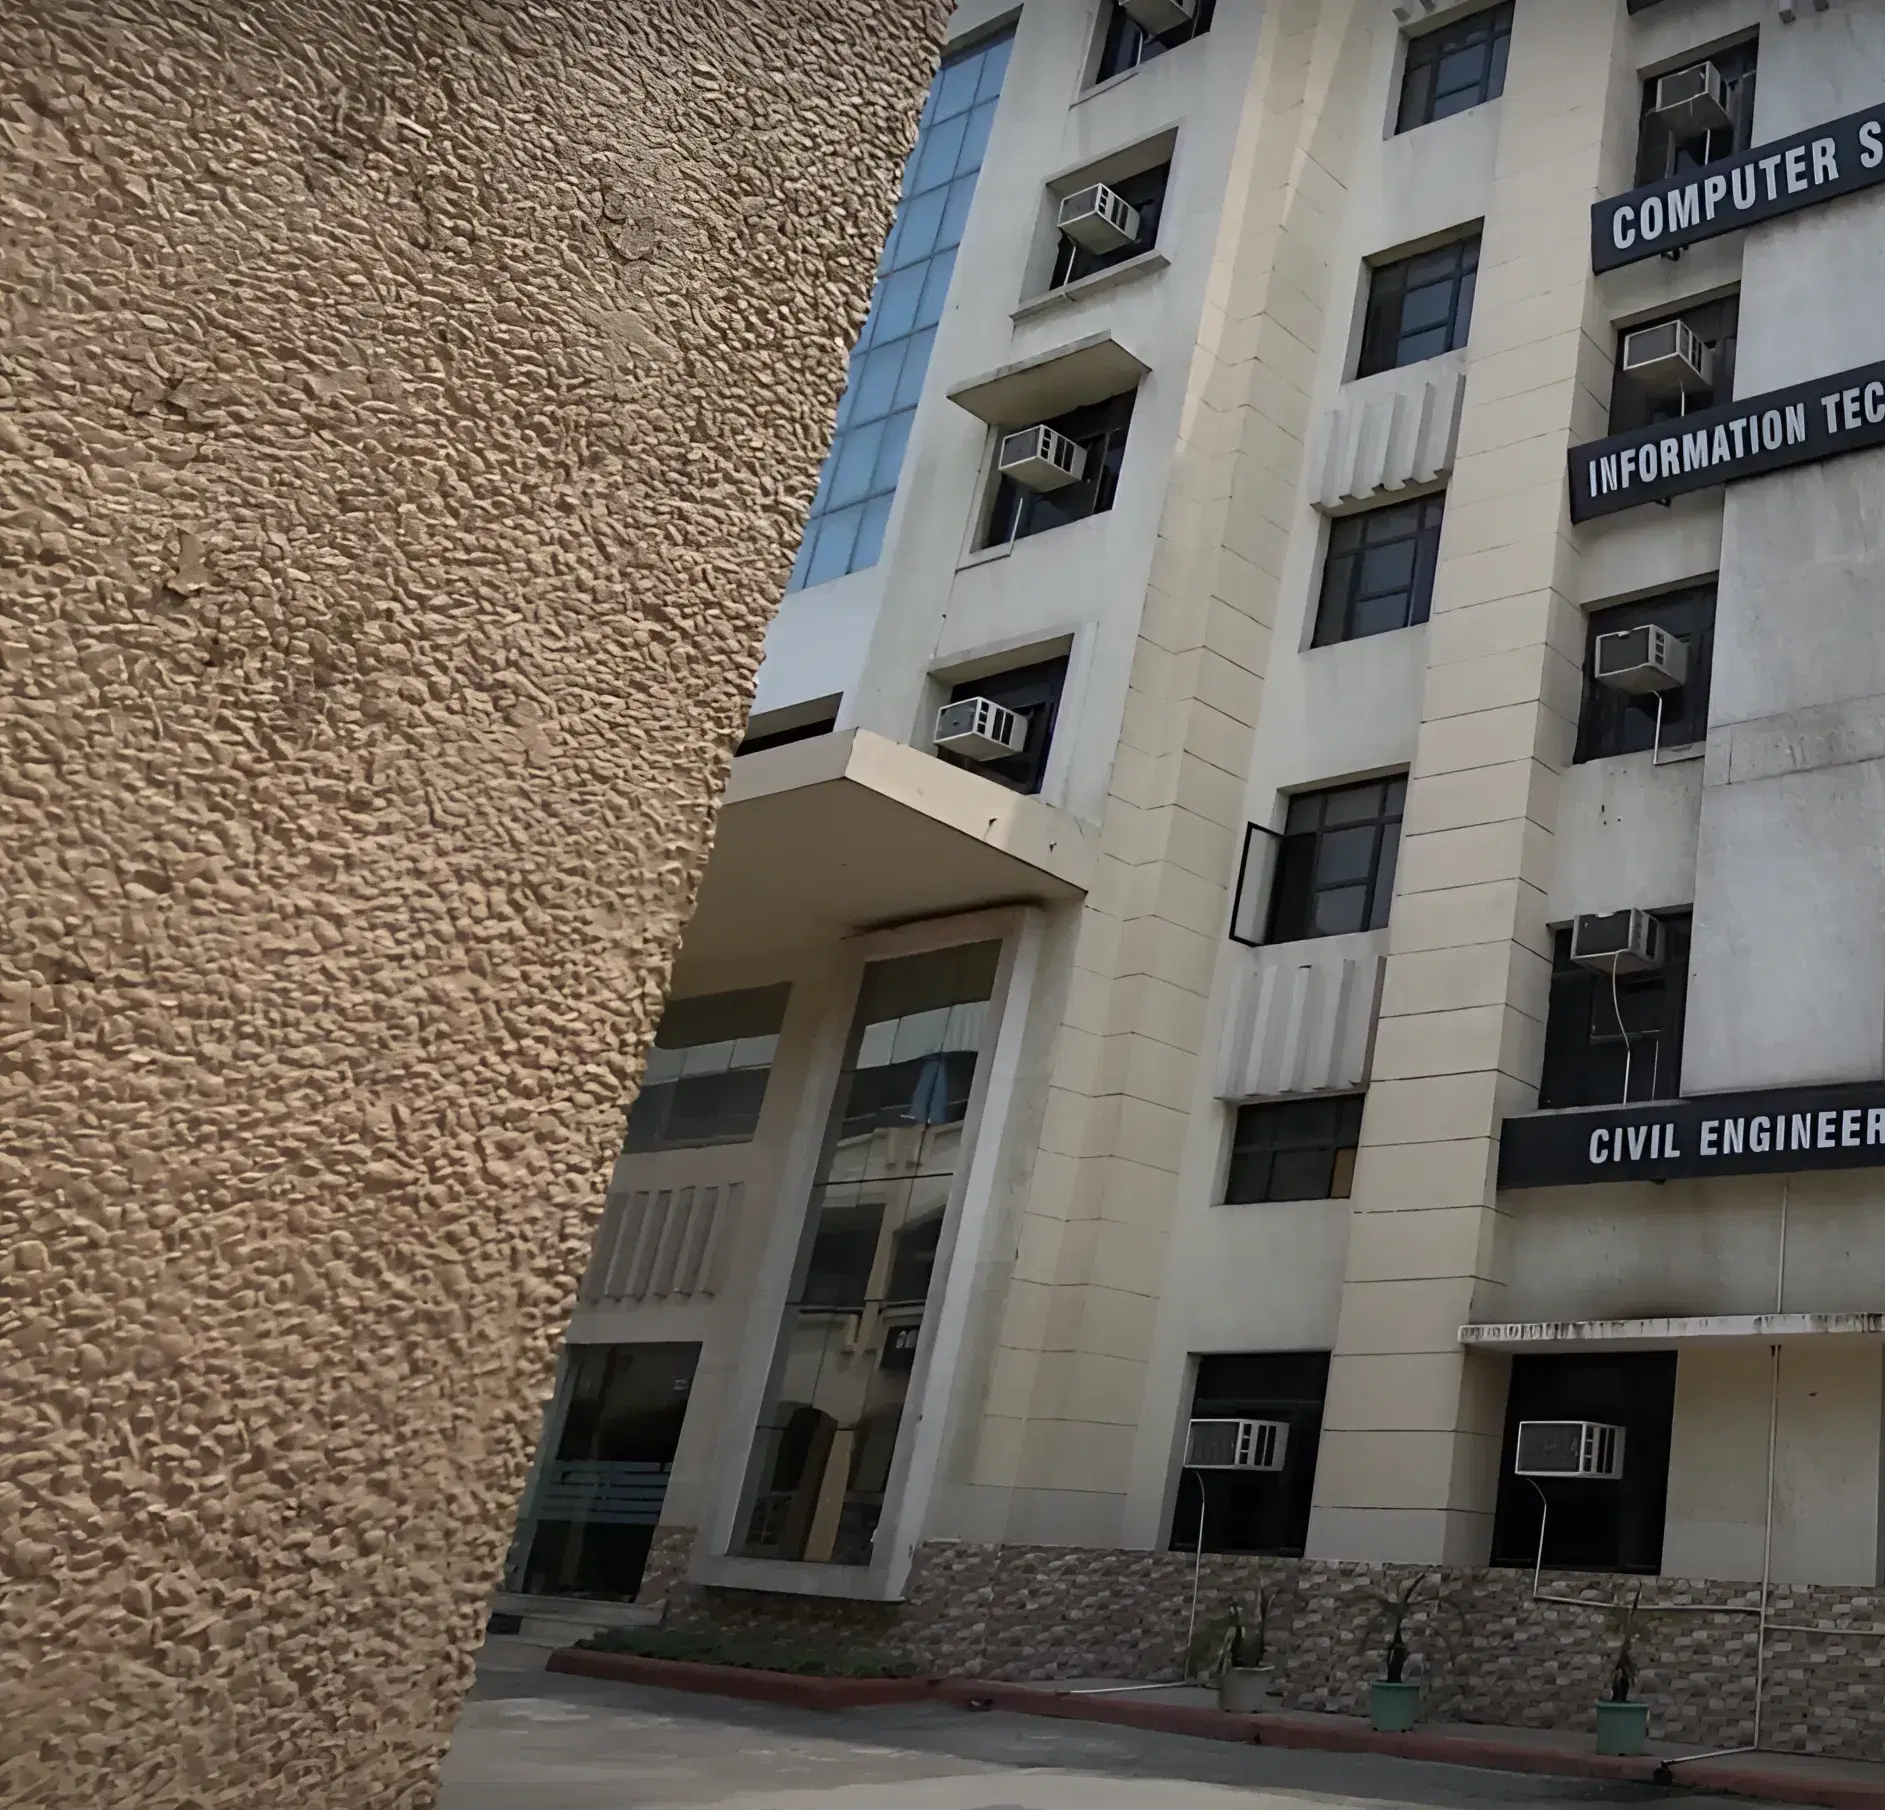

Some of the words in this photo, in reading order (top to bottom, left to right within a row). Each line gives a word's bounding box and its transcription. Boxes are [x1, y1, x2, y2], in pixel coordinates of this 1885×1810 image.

[1612, 137, 1839, 250] COMPUTER
[1588, 402, 1806, 498] INFORMATION
[1588, 1123, 1681, 1164] CIVIL
